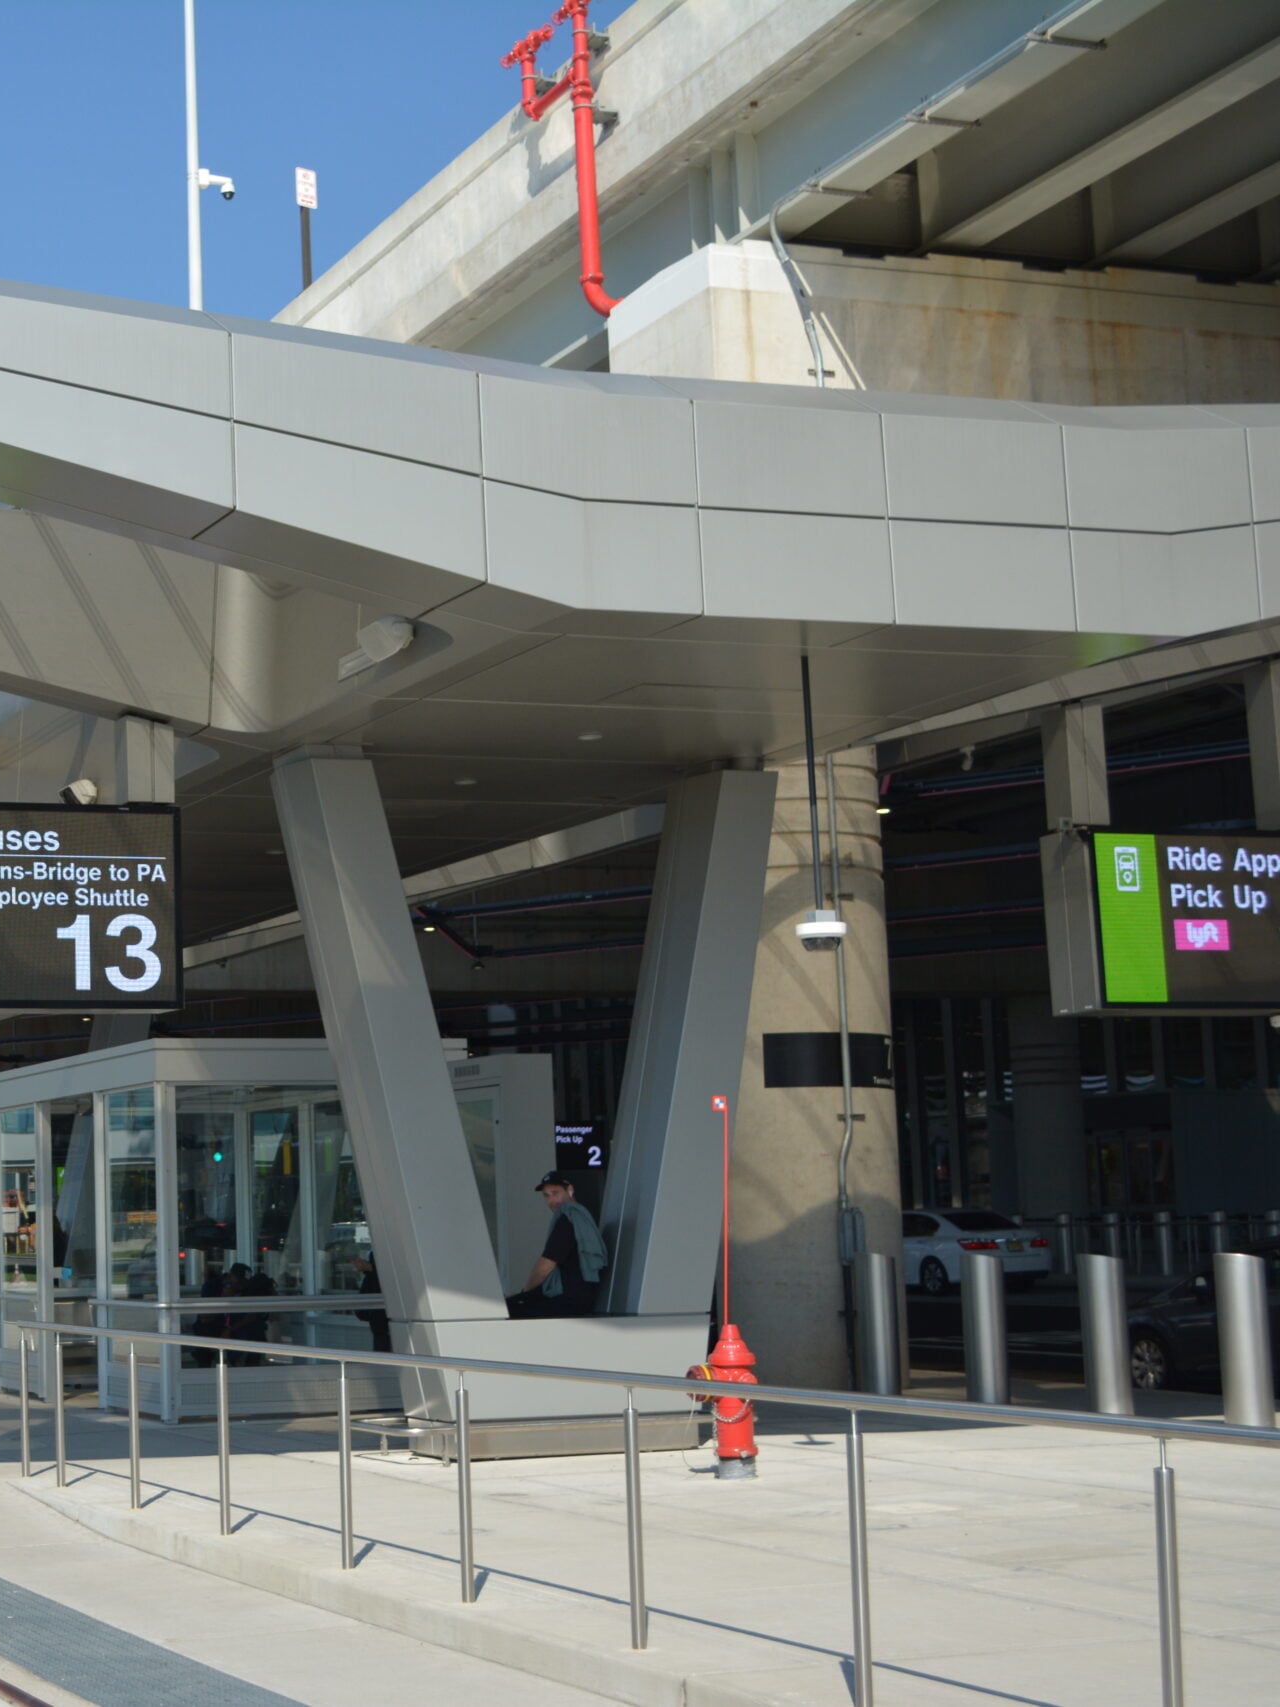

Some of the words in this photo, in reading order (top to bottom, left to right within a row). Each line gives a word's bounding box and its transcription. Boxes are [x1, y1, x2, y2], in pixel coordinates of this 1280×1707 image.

[108, 863, 129, 882] to
[137, 863, 166, 882] PA
[1167, 846, 1222, 871] Ride
[1233, 847, 1280, 878] App
[74, 888, 149, 907] Shuttle
[1170, 883, 1223, 908] Pick
[1233, 884, 1267, 914] Up
[1186, 922, 1219, 948] lyft
[56, 913, 162, 992] 13
[555, 1125, 593, 1135] Passenger
[556, 1135, 571, 1143] Pick
[572, 1135, 583, 1144] Up
[588, 1145, 602, 1166] 2
